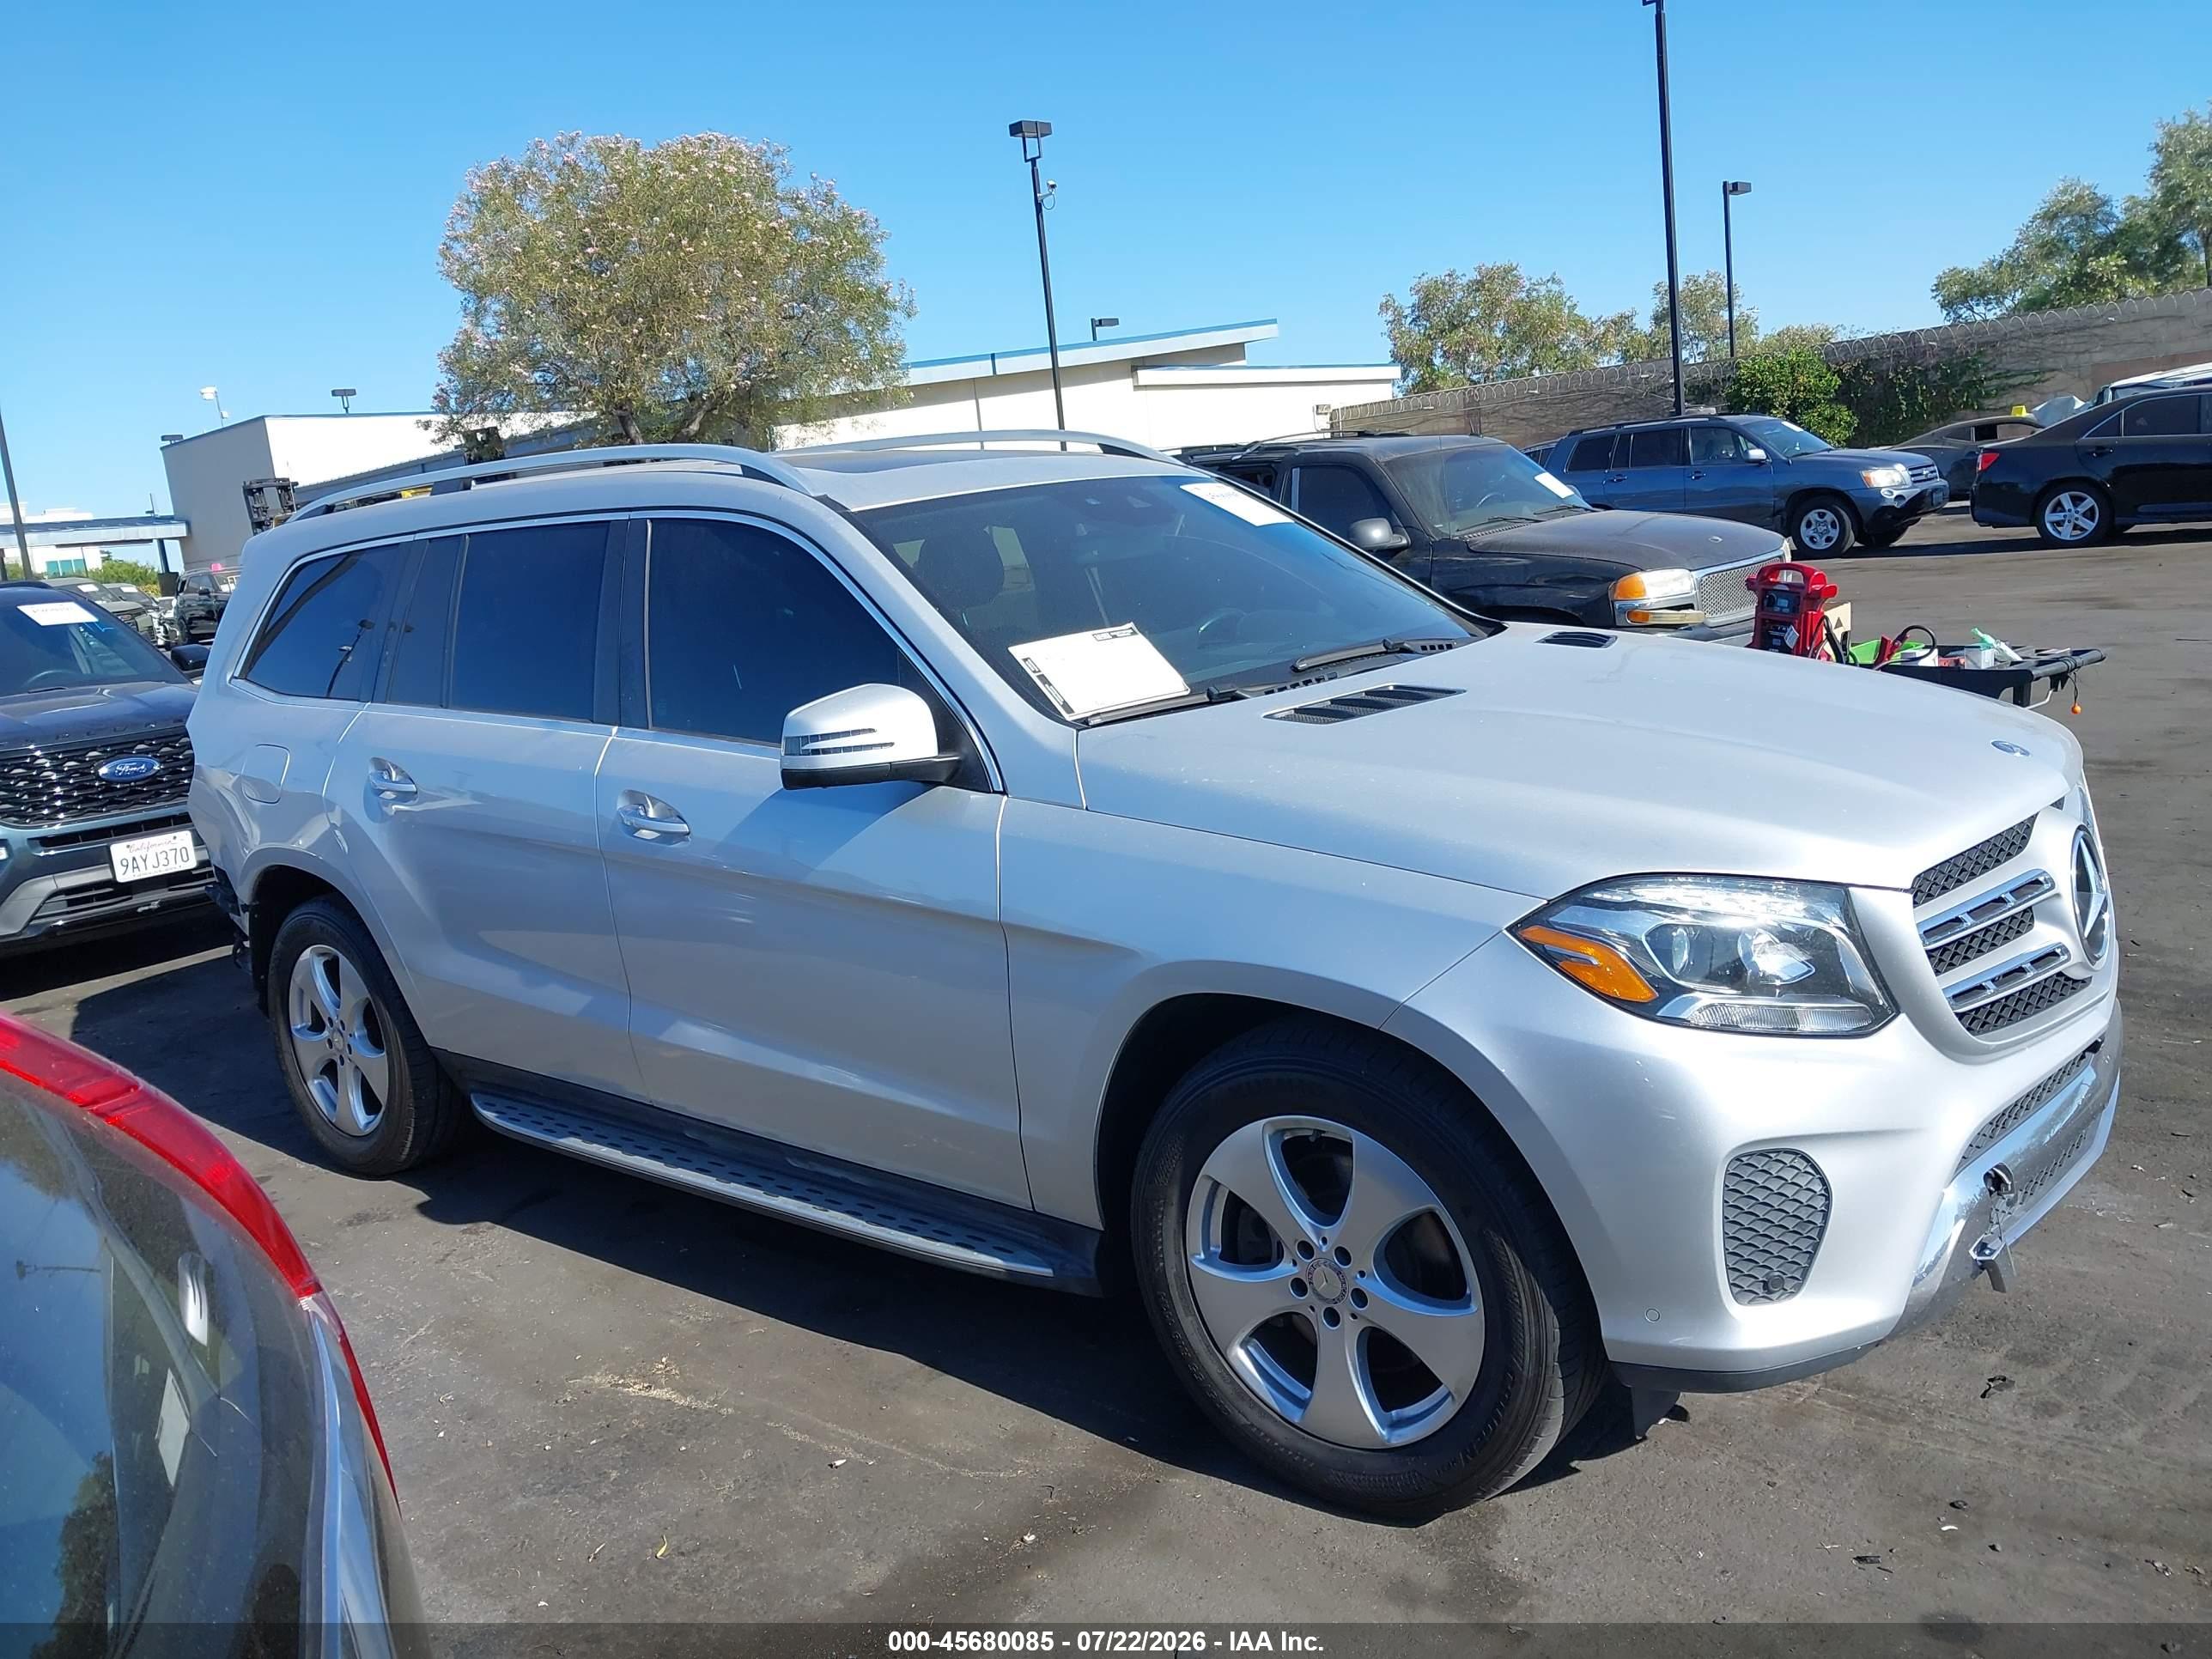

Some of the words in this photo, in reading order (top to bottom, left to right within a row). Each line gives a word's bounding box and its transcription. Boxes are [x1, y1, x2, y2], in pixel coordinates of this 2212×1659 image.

[114, 762, 147, 776] Ford
[129, 839, 173, 854] California
[120, 846, 190, 876] 9AYJ370
